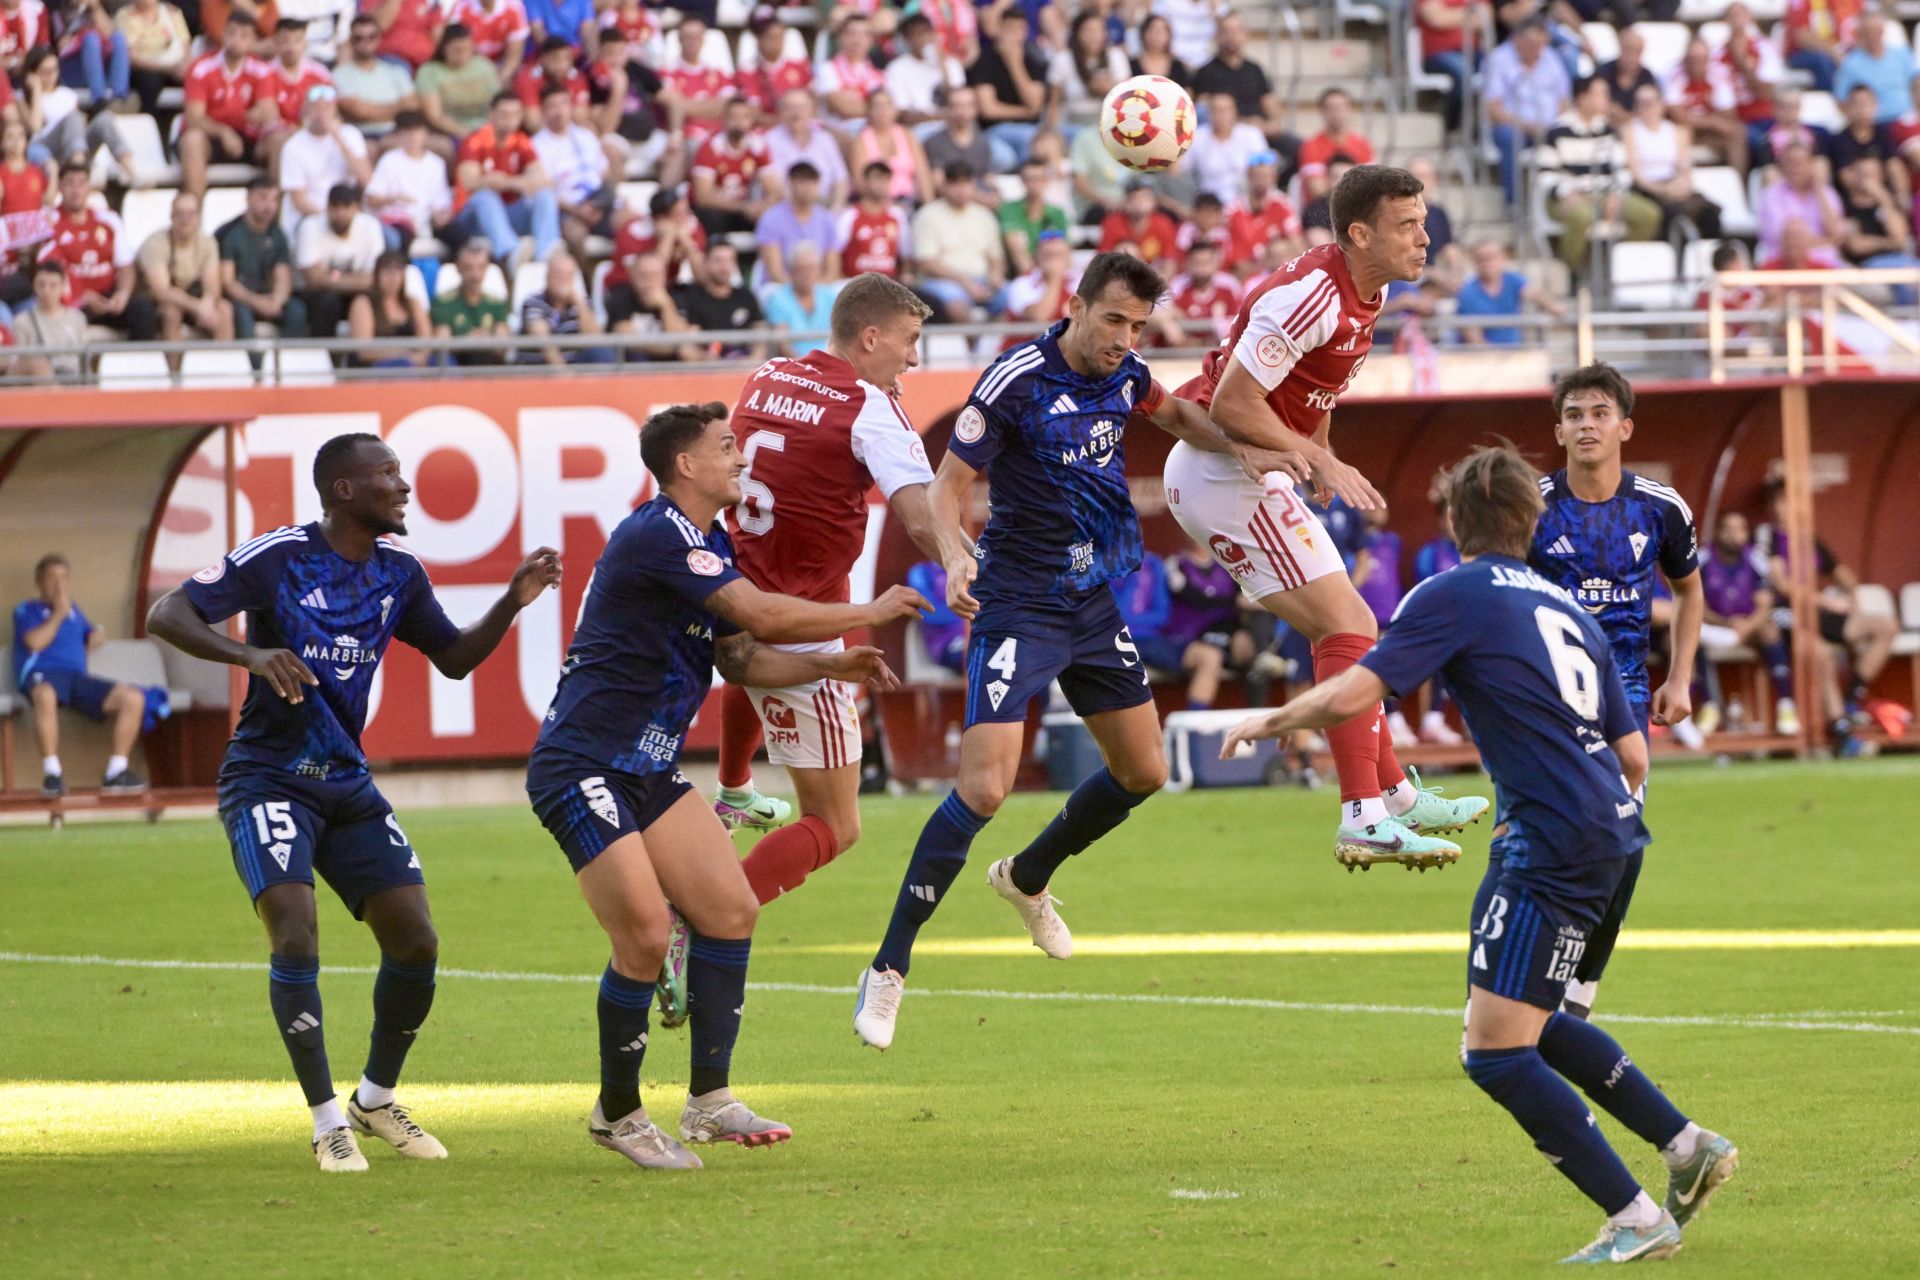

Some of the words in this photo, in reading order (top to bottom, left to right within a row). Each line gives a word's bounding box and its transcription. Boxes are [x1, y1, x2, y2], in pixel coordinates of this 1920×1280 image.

[769, 370, 850, 402] aparcamurcia
[745, 390, 759, 411] A.
[762, 394, 826, 426] MARIN
[736, 429, 785, 537] 6
[1564, 588, 1640, 603] ARBELLA
[987, 637, 1018, 681] 4
[1534, 605, 1599, 721] 6
[637, 734, 674, 761] laga
[251, 801, 298, 845] 15
[1562, 939, 1586, 962] m
[1604, 1055, 1632, 1089] MFC
